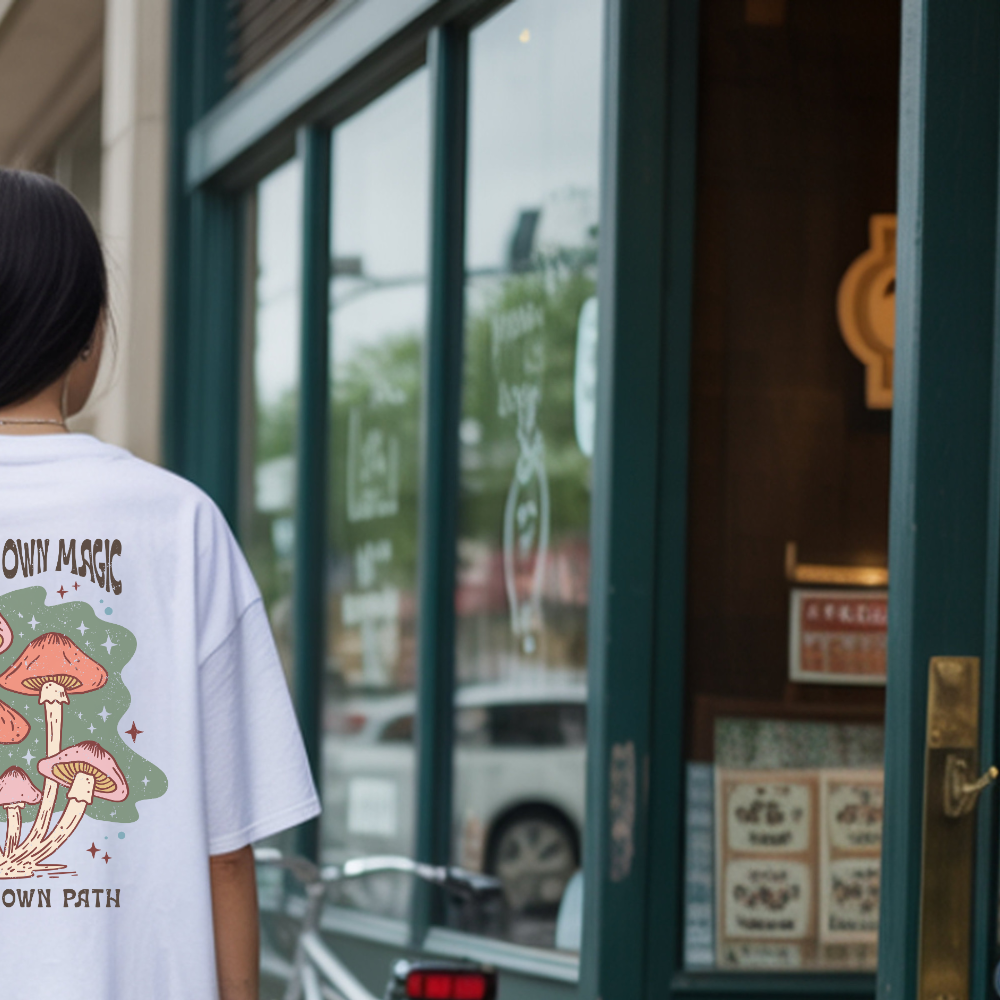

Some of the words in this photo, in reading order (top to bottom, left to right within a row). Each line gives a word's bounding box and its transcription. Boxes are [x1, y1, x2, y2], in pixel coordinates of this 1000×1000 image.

[1, 538, 50, 579] OWN
[55, 538, 123, 595] MAGIC
[1, 888, 52, 908] OWN
[62, 888, 121, 908] PATH
